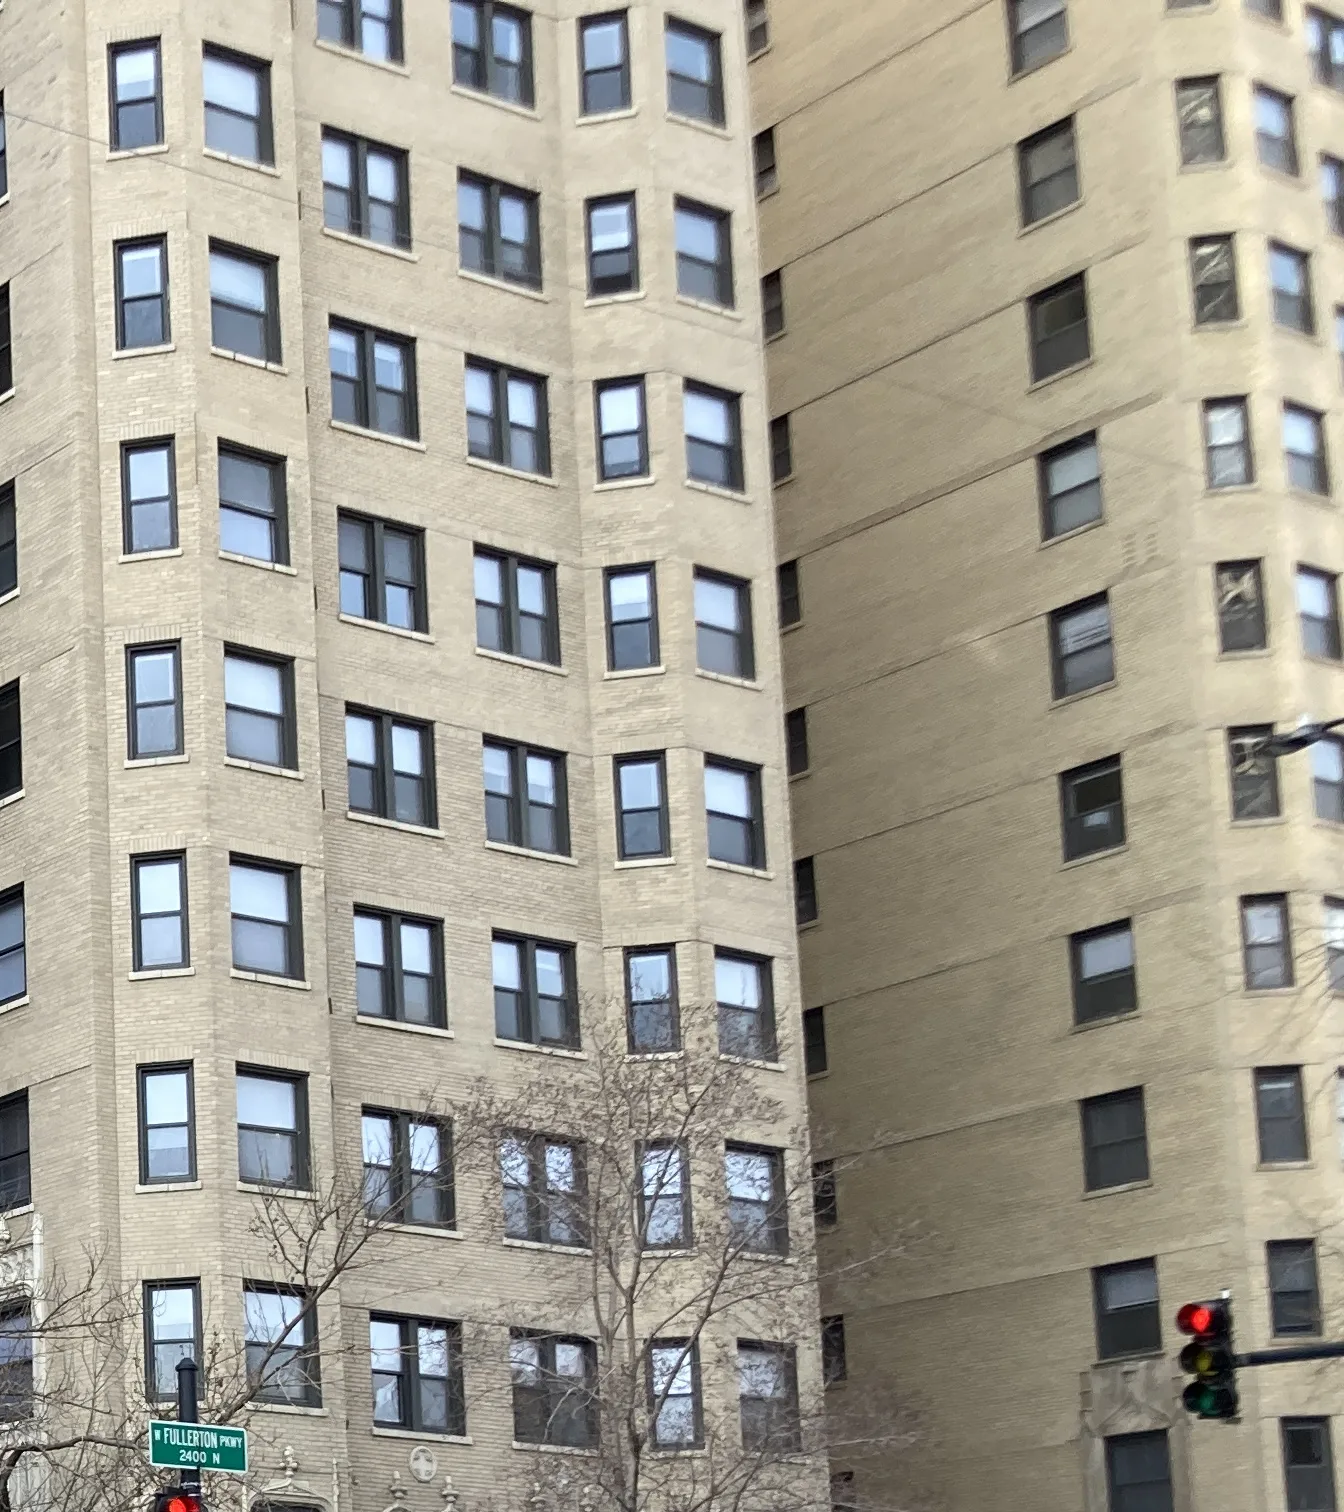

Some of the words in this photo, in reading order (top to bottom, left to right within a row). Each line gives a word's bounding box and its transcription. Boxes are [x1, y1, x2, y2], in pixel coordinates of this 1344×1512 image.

[154, 1429, 161, 1441] W
[163, 1427, 218, 1449] FULLERTON
[219, 1435, 242, 1449] PKWY
[179, 1449, 207, 1464] 2400
[213, 1452, 221, 1465] N
